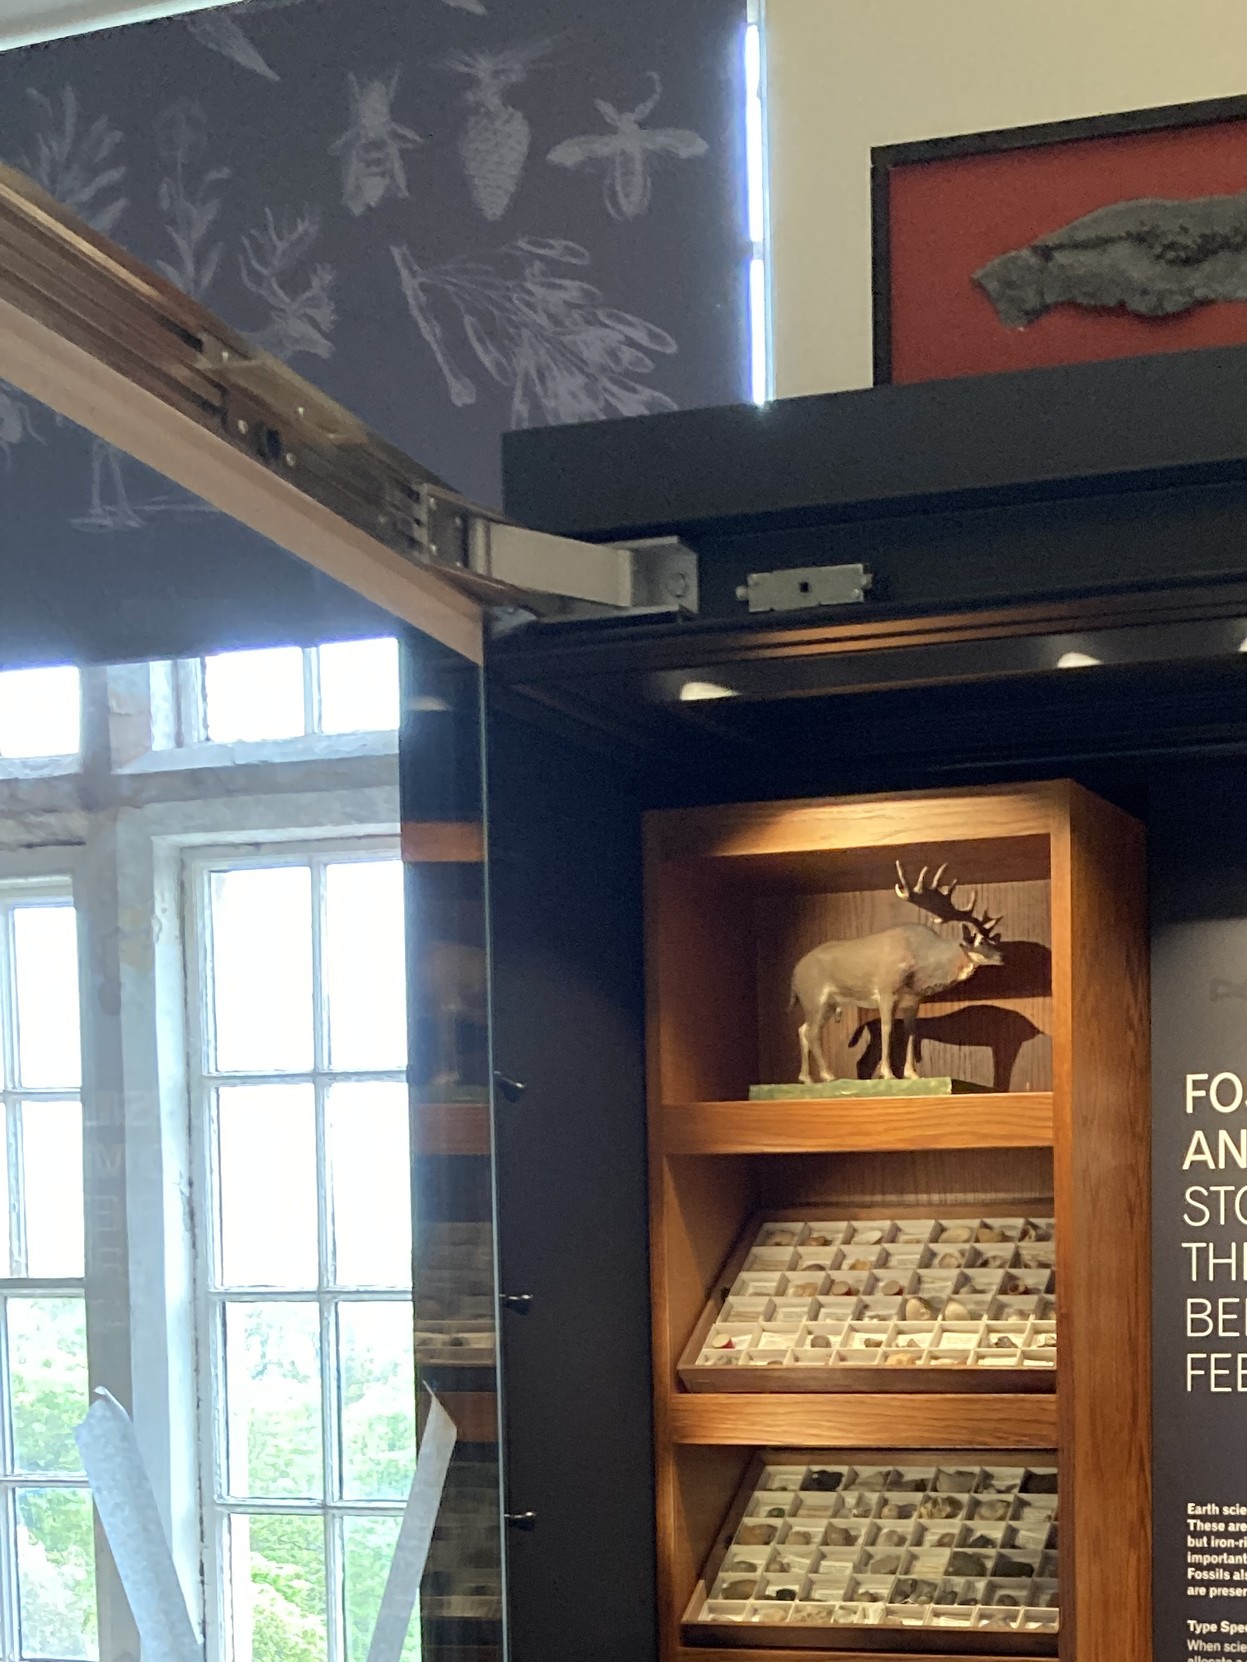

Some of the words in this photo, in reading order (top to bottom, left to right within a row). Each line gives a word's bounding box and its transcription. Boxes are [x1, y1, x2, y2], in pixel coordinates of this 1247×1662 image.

[1186, 1501, 1220, 1515] Earth
[1186, 1518, 1226, 1531] These
[1226, 1521, 1247, 1532] are
[1186, 1534, 1208, 1548] but
[1186, 1550, 1247, 1567] important
[1186, 1566, 1231, 1580] Fossils
[1186, 1585, 1207, 1596] are
[1187, 1618, 1218, 1635] Type
[1186, 1638, 1221, 1652] When
